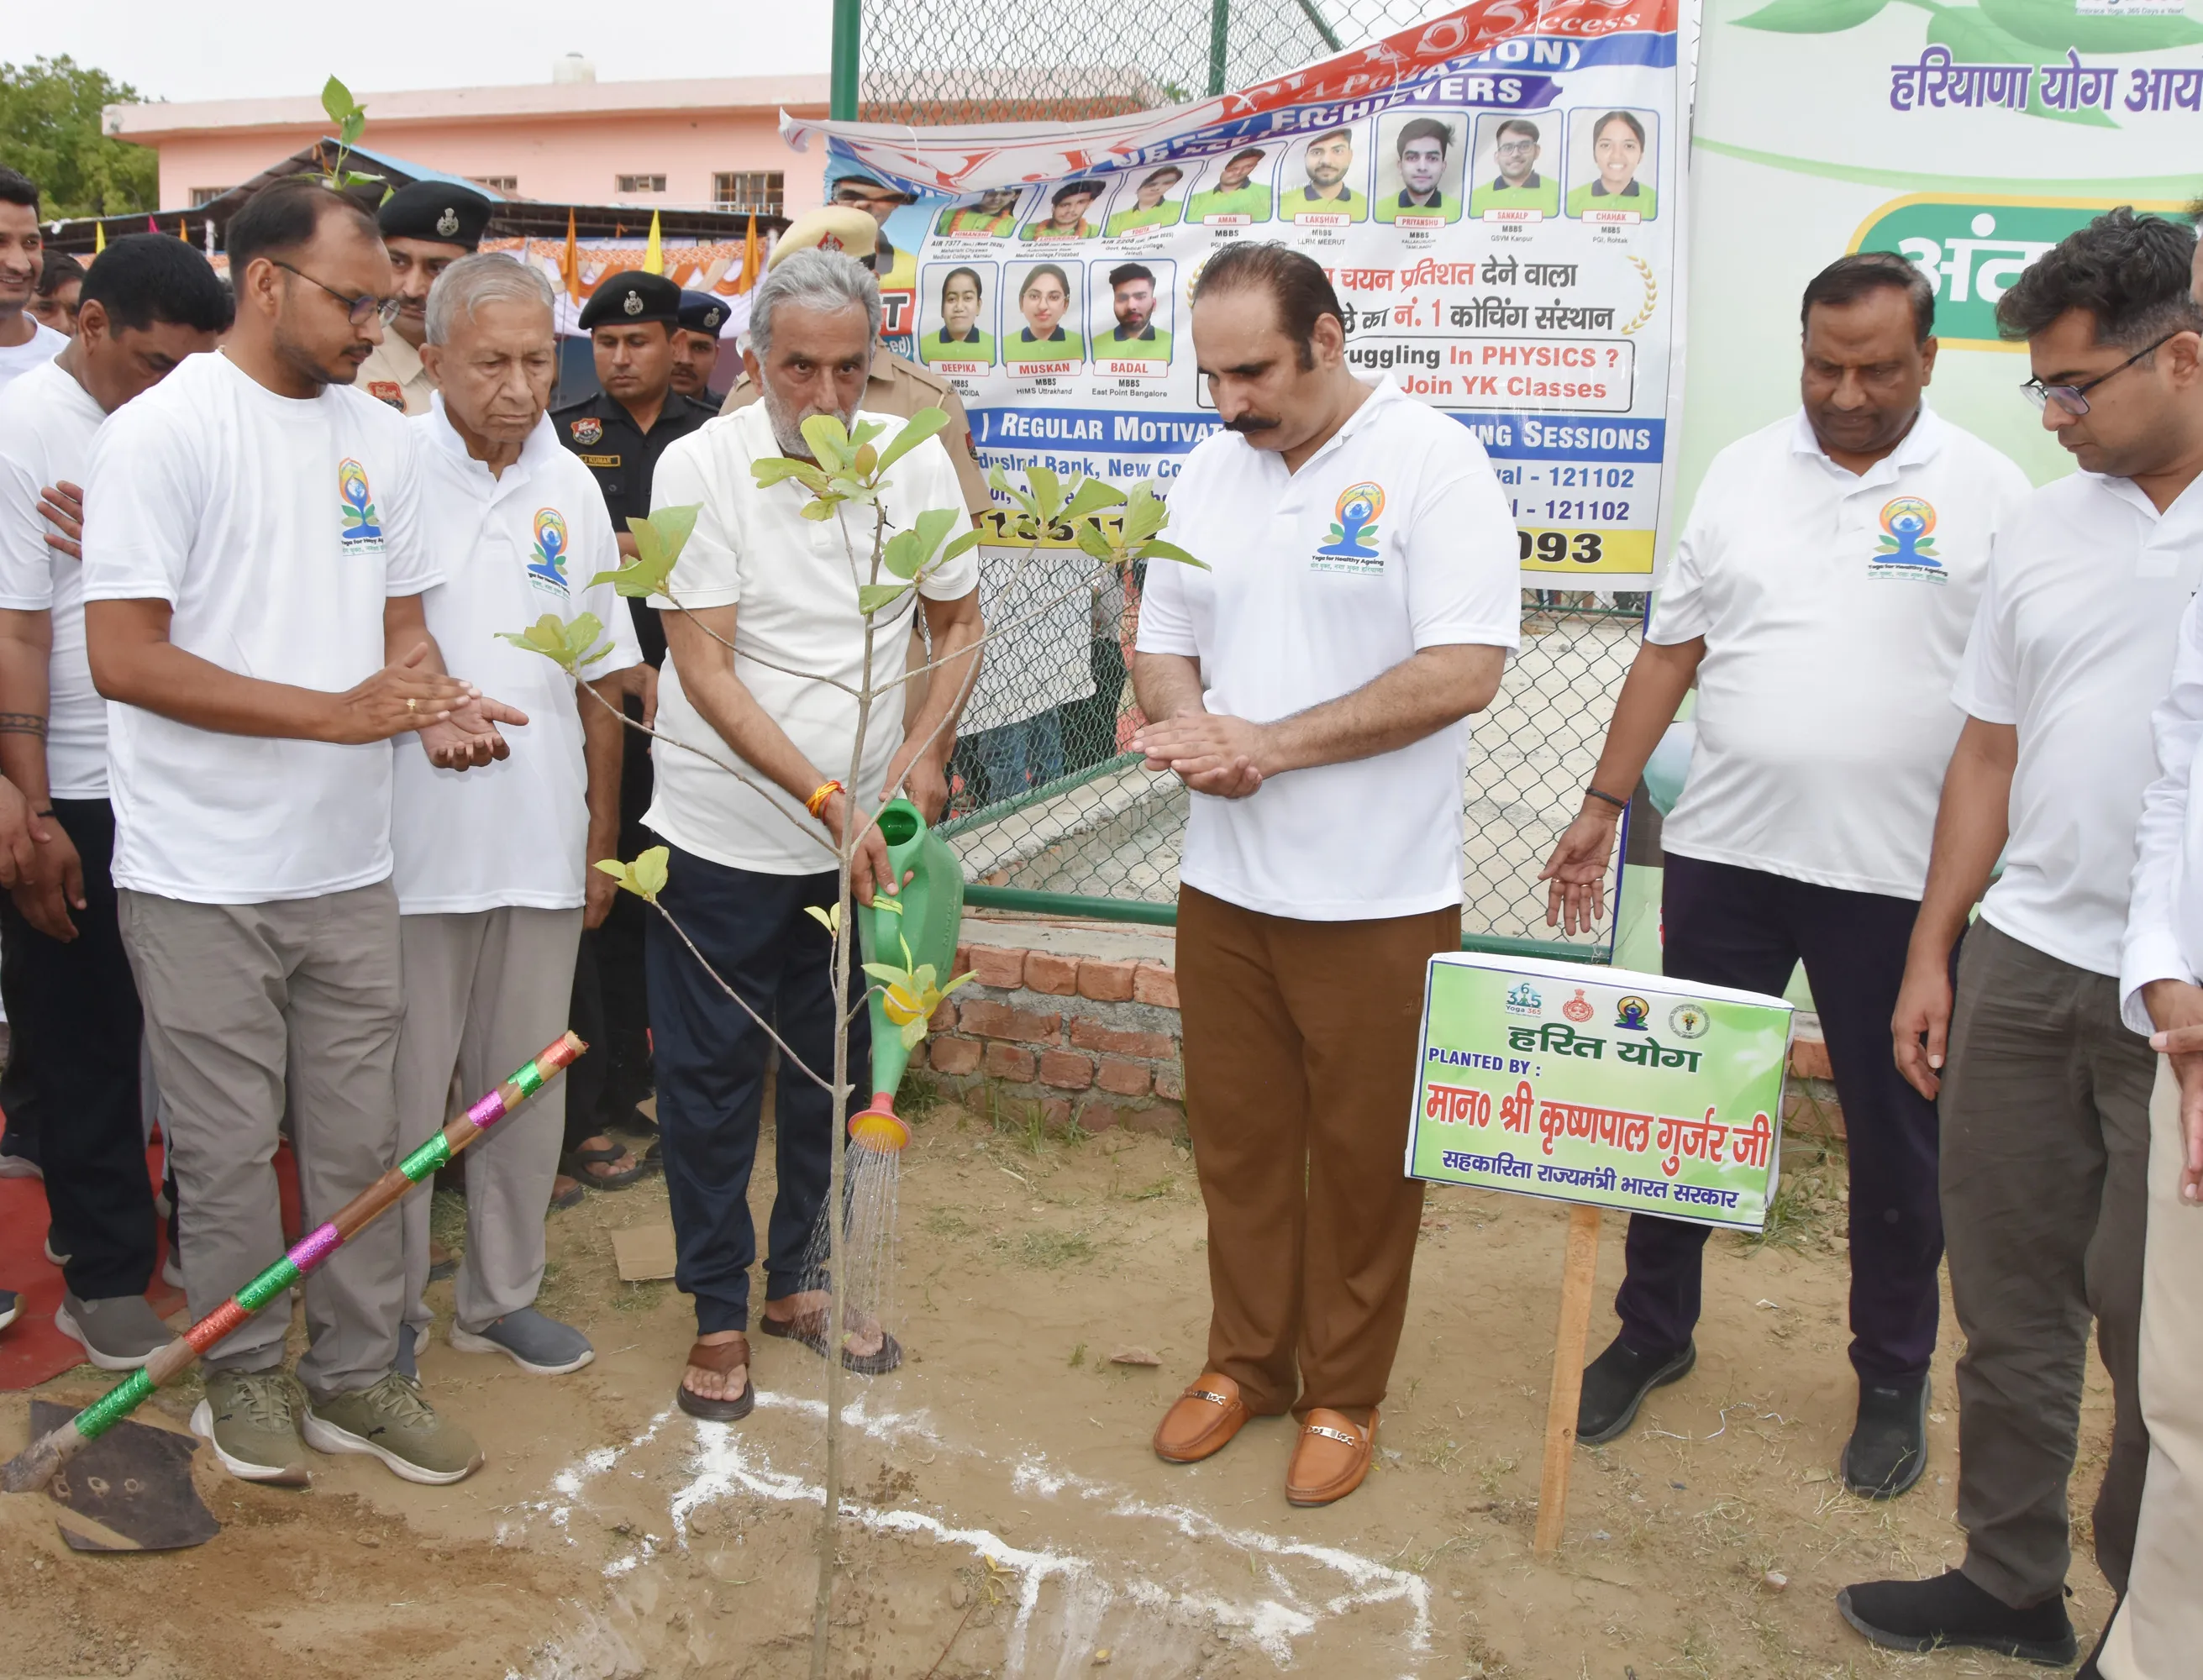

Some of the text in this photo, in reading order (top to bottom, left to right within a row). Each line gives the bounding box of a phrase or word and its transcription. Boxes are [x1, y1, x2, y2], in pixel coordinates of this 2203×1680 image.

[1890, 47, 2203, 113] हरियाणा योग आय
[1305, 215, 1339, 223] LAKSHAY
[1496, 211, 1529, 220] SANKALP
[1596, 212, 1627, 222] CHAHAK
[1401, 218, 1438, 226] PRIYANSHU
[1215, 229, 1239, 238] MBBS
[1501, 224, 1523, 233] MBBS
[1601, 226, 1621, 234] MBBS
[1340, 267, 1395, 291] चयन
[1400, 257, 1475, 294] प्रतिशत
[1481, 255, 1519, 286] देने
[1524, 263, 1579, 288] वाला
[1361, 307, 1390, 330] का
[1431, 298, 1441, 328] 1
[1450, 296, 1529, 329] कोचिंग
[1534, 297, 1615, 330] संस्थान
[1449, 345, 1473, 365] In
[1482, 346, 1596, 368] PHYSICS
[1606, 348, 1619, 368] ?
[941, 363, 976, 374] DEEPIKA
[1018, 362, 1070, 375] MUSKAN
[1110, 362, 1149, 374] BADAL
[1035, 378, 1057, 386] MBBS
[1118, 379, 1140, 388] MBBS
[1400, 375, 1606, 398] Join YK Classes
[1038, 387, 1073, 396] Uttrakhand
[1109, 388, 1128, 396] Point
[1129, 389, 1168, 398] Bangalore
[1108, 459, 1150, 478] New
[1548, 467, 1635, 488] 121102
[1545, 500, 1630, 521] 121102
[1335, 556, 1360, 564] Healthy
[1360, 558, 1385, 566] Ageing
[1506, 1005, 1526, 1013] Yoga
[1527, 1007, 1542, 1016] 365
[1507, 1022, 1702, 1074] हरित योग
[1428, 1047, 1503, 1072] PLANTED
[1509, 1059, 1531, 1075] BY
[1500, 1080, 1535, 1135] श्री
[1538, 1100, 1654, 1156] कृष्णपाल
[1656, 1107, 1728, 1177] गुर्जर
[1732, 1114, 1772, 1168] जी
[1442, 1149, 1740, 1210] सहकारिता राज्यमंत्री भारत सरकार
